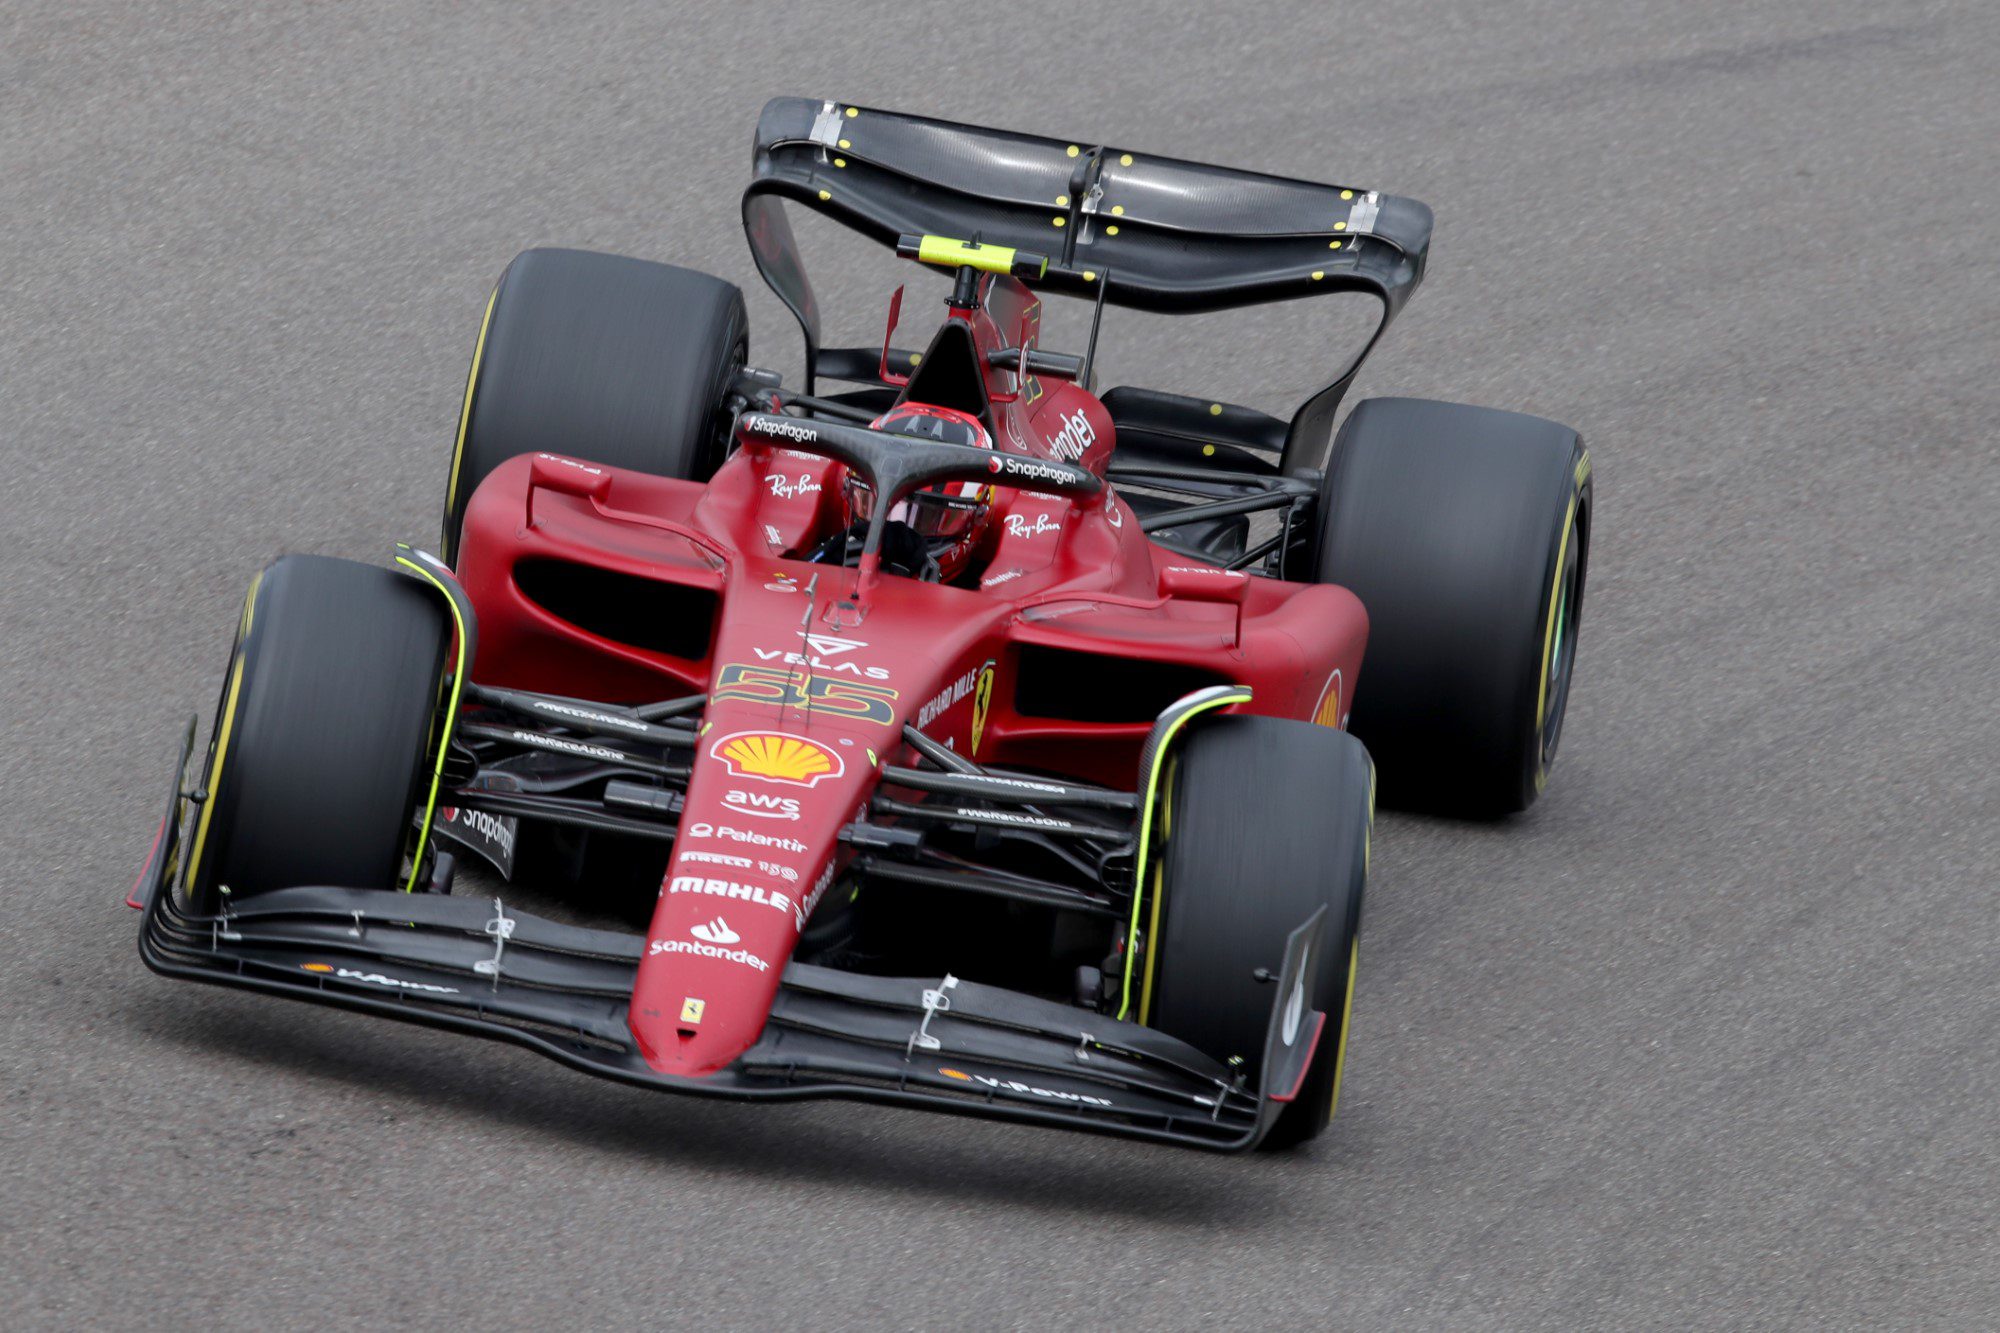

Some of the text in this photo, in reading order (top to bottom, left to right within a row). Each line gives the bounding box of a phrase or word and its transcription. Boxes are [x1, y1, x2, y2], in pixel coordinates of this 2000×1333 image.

[754, 417, 817, 443] Snapdragon
[1006, 458, 1076, 485] Snapdragon
[765, 474, 822, 499] Ray-Ban
[1004, 513, 1061, 539] Ray-Ban
[753, 647, 890, 680] VELAS
[711, 663, 899, 727] 55
[725, 789, 801, 814] aws
[716, 826, 808, 853] Palantir
[669, 876, 792, 914] MAHLE
